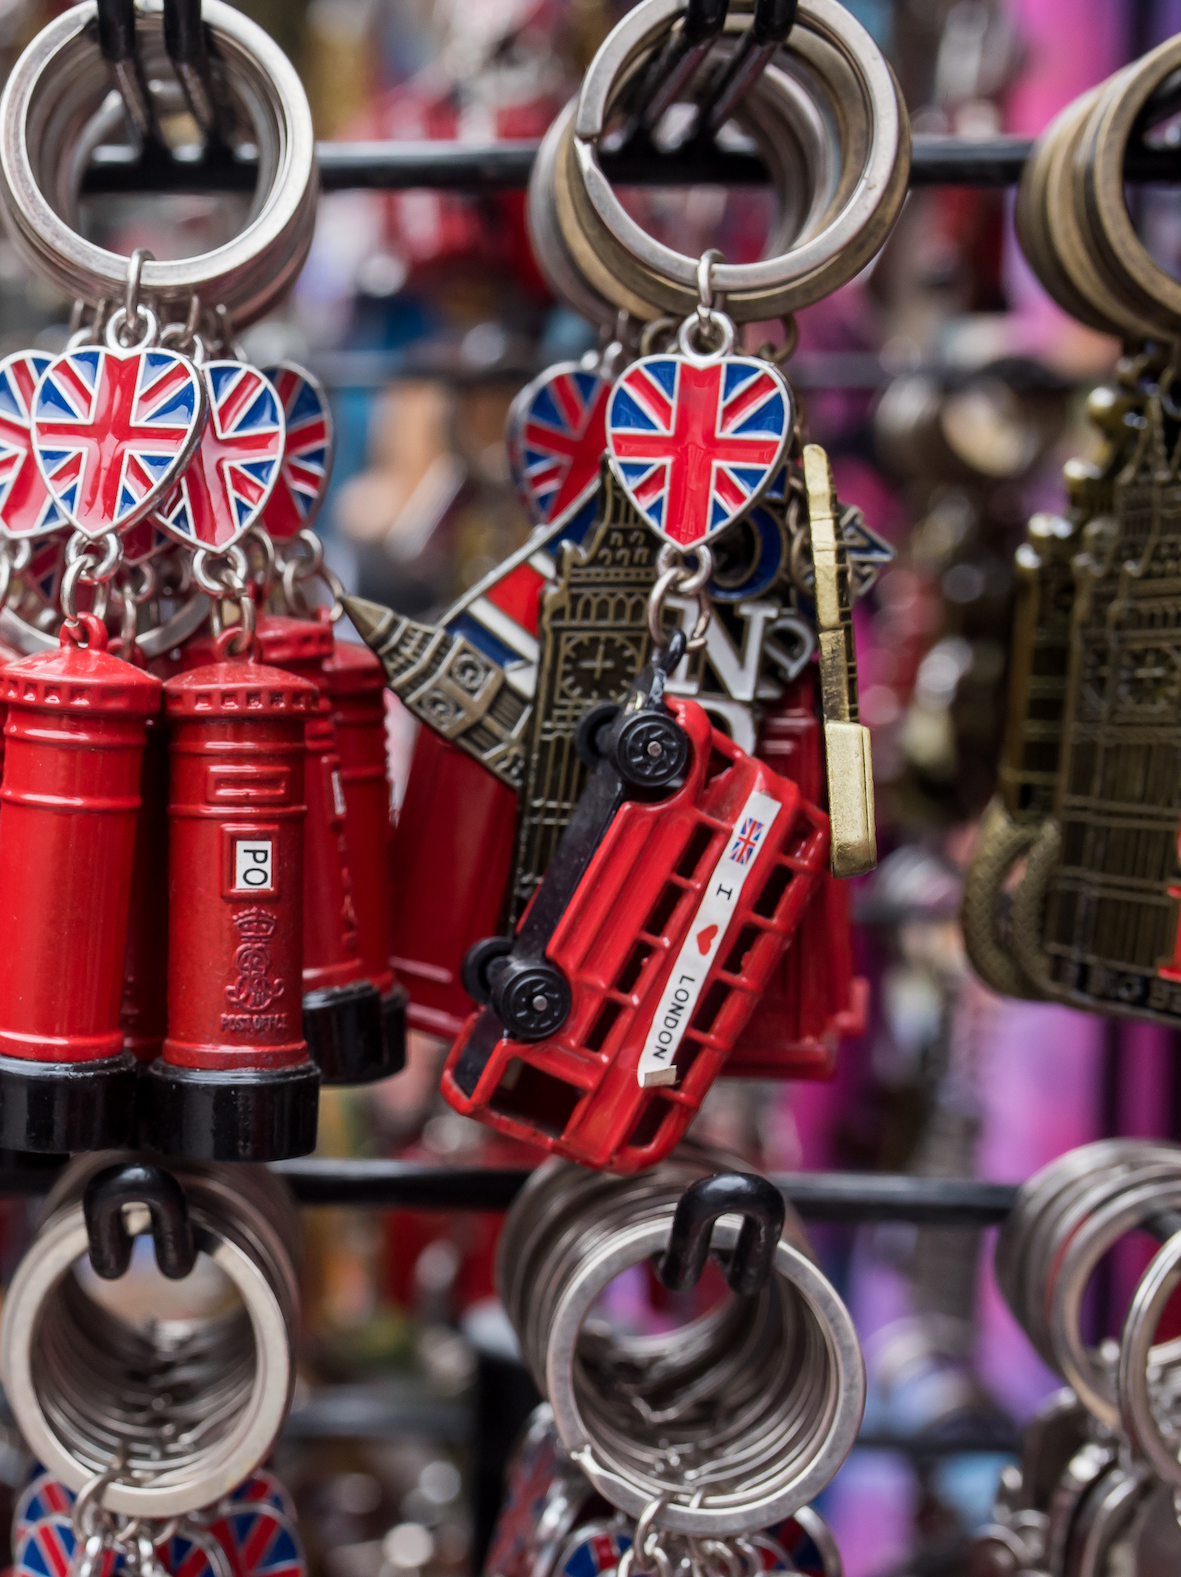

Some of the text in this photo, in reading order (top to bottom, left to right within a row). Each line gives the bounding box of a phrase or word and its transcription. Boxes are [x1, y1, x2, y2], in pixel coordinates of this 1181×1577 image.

[243, 849, 268, 886] PO
[652, 883, 733, 1060] I LONDON
